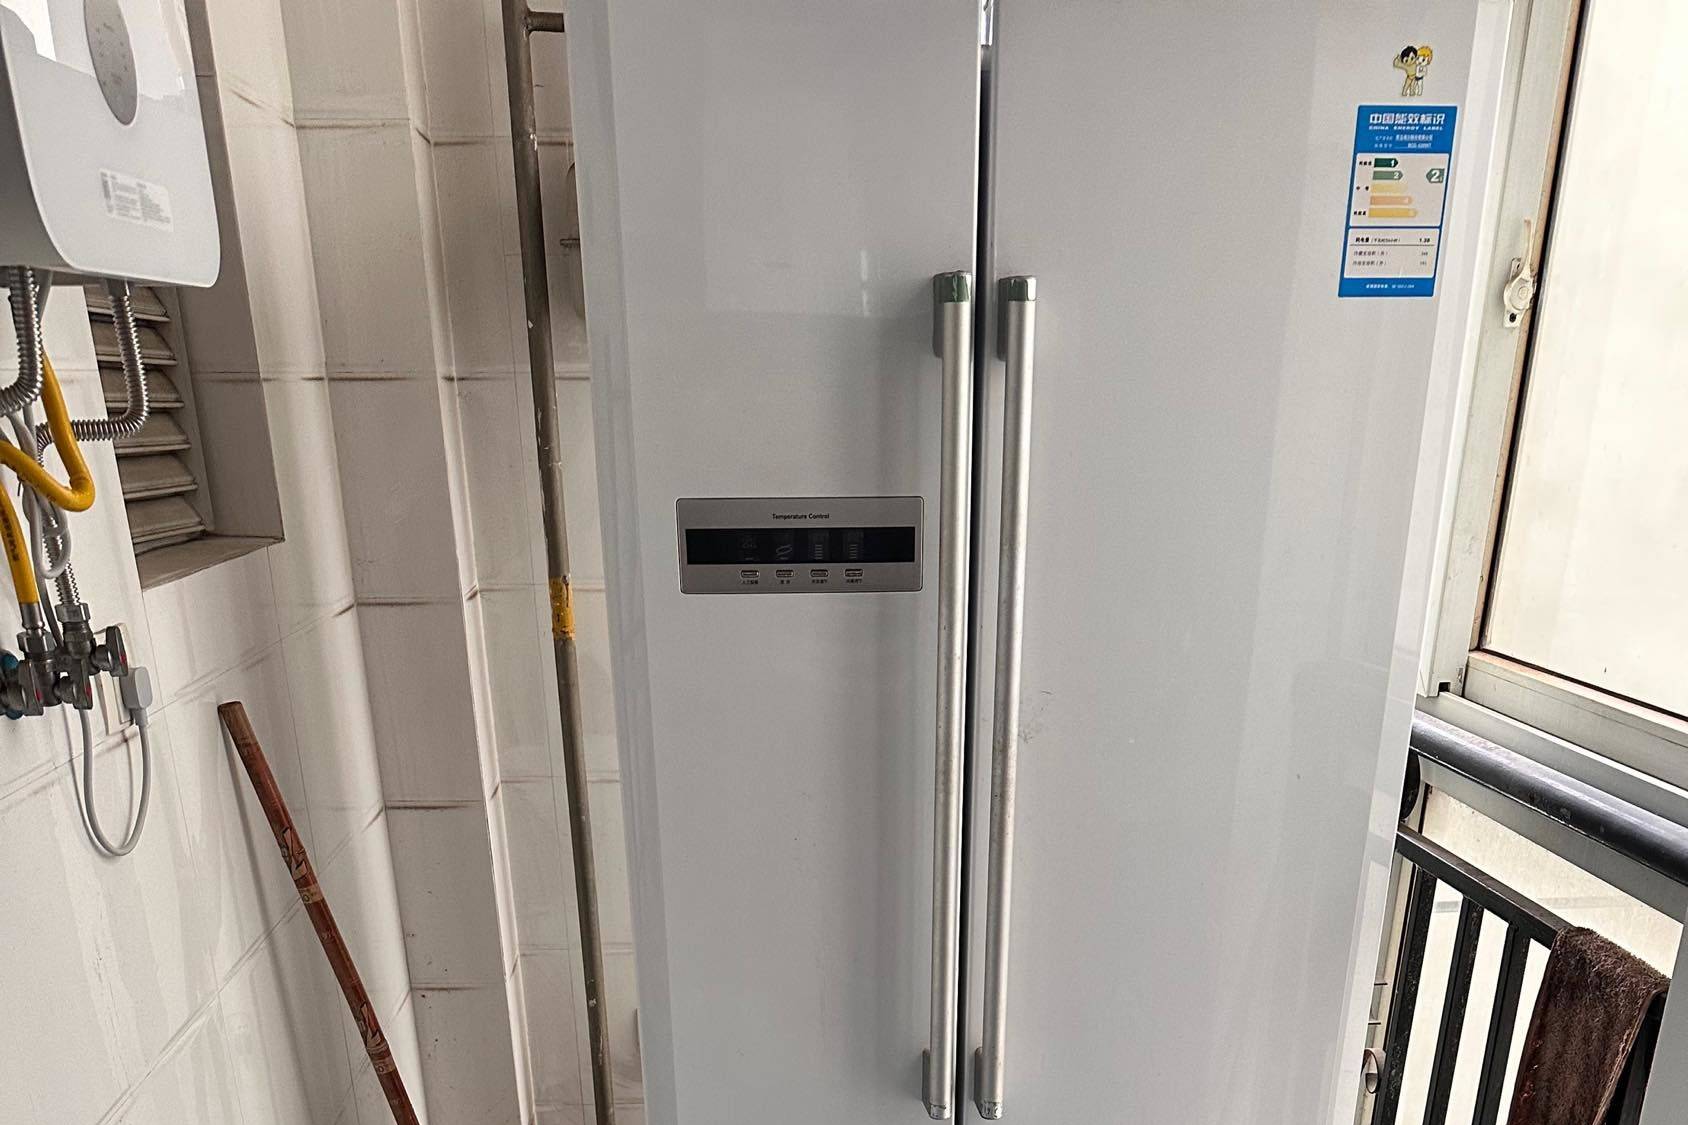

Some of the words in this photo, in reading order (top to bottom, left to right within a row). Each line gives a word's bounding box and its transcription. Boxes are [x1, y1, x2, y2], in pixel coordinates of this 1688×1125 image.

[1369, 113, 1445, 125] 中国能效标识
[1393, 171, 1399, 179] 2
[1431, 169, 1440, 182] 2
